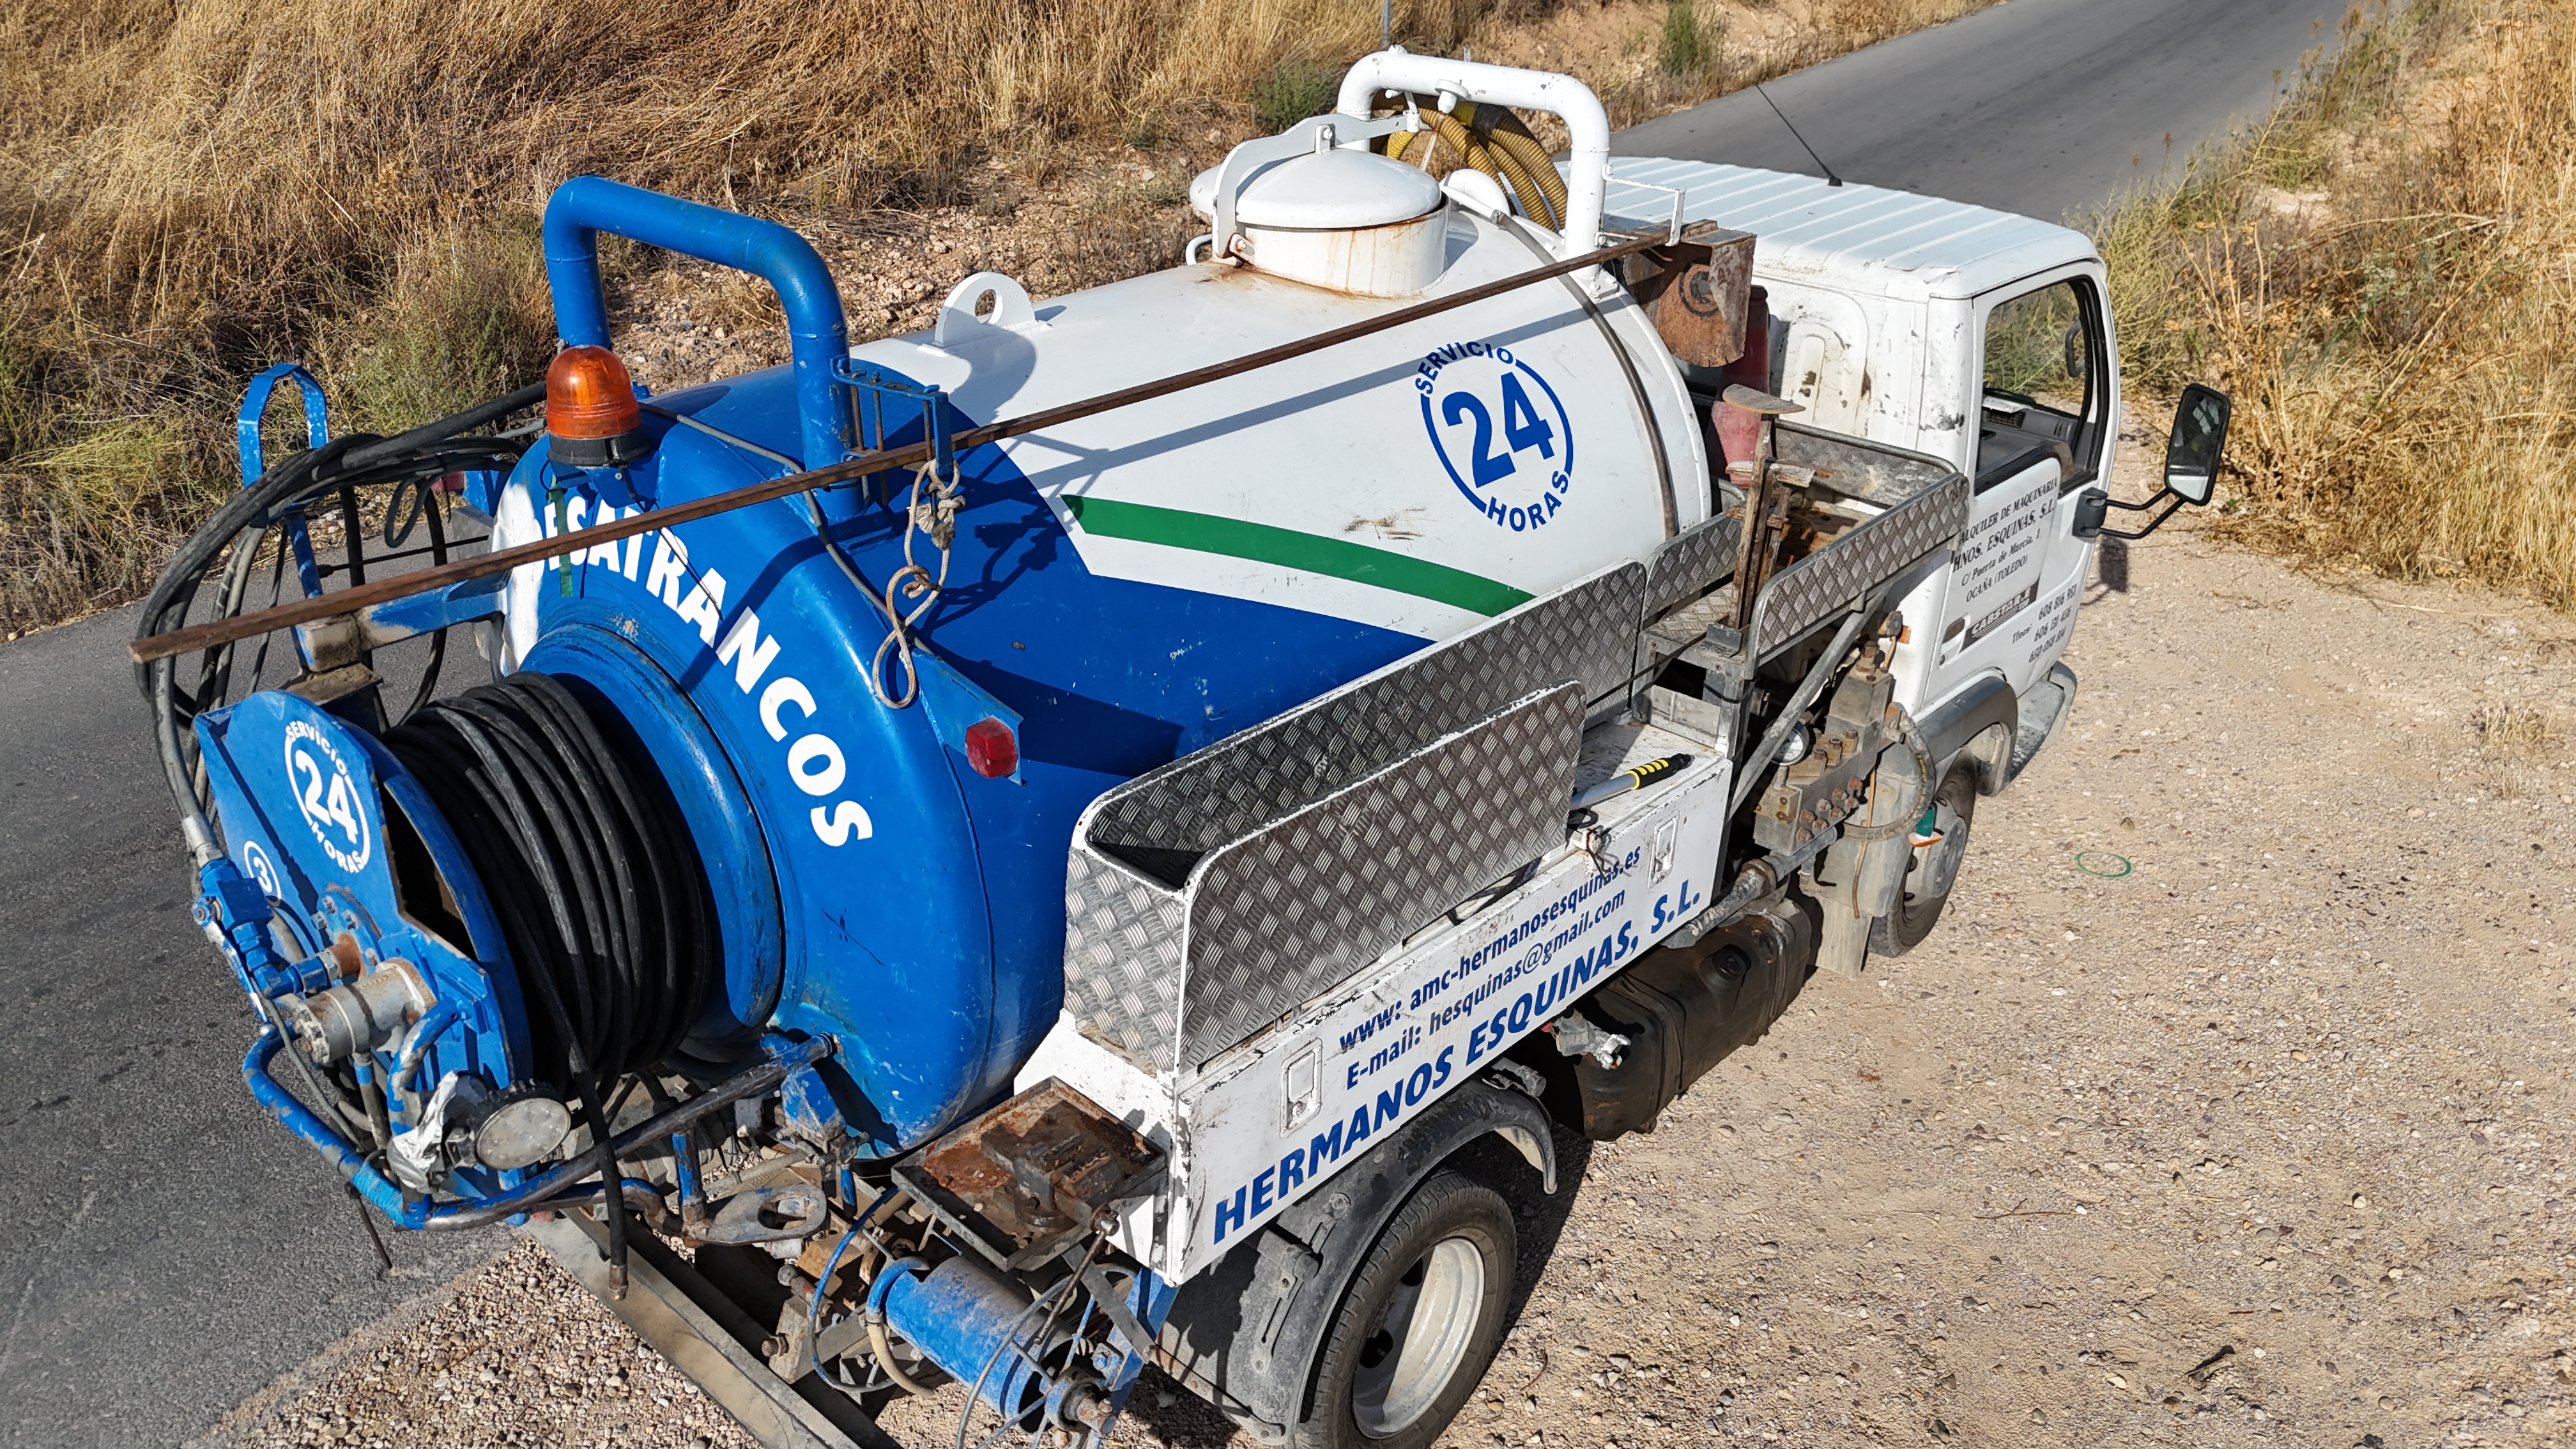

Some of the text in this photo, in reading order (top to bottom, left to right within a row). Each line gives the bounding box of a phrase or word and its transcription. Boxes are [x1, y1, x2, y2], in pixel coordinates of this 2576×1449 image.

[1415, 342, 1514, 394] SERVICIO
[1442, 372, 1554, 488] 24
[1487, 471, 1568, 532] HORAS
[1959, 477, 2057, 545] ALQUILER DE MAQUINARIA
[1952, 542, 1983, 573] HNOS.
[1966, 555, 2028, 602] OCAÑA (TOLEDO)
[1972, 559, 1996, 580] Puerta
[1998, 550, 2007, 564] de
[2034, 622, 2049, 642] 606
[286, 721, 347, 775] SERVICIO
[295, 749, 358, 844] 24
[311, 821, 364, 873] HORAS
[254, 857, 272, 893] 3
[1410, 846, 1641, 1011] amc-hermanosesquinas.es
[1347, 889, 1625, 1090] E-mail: hesquinas@gmail.com
[1214, 879, 1700, 1245] HERMANOS ESQUINAS, S.L.
